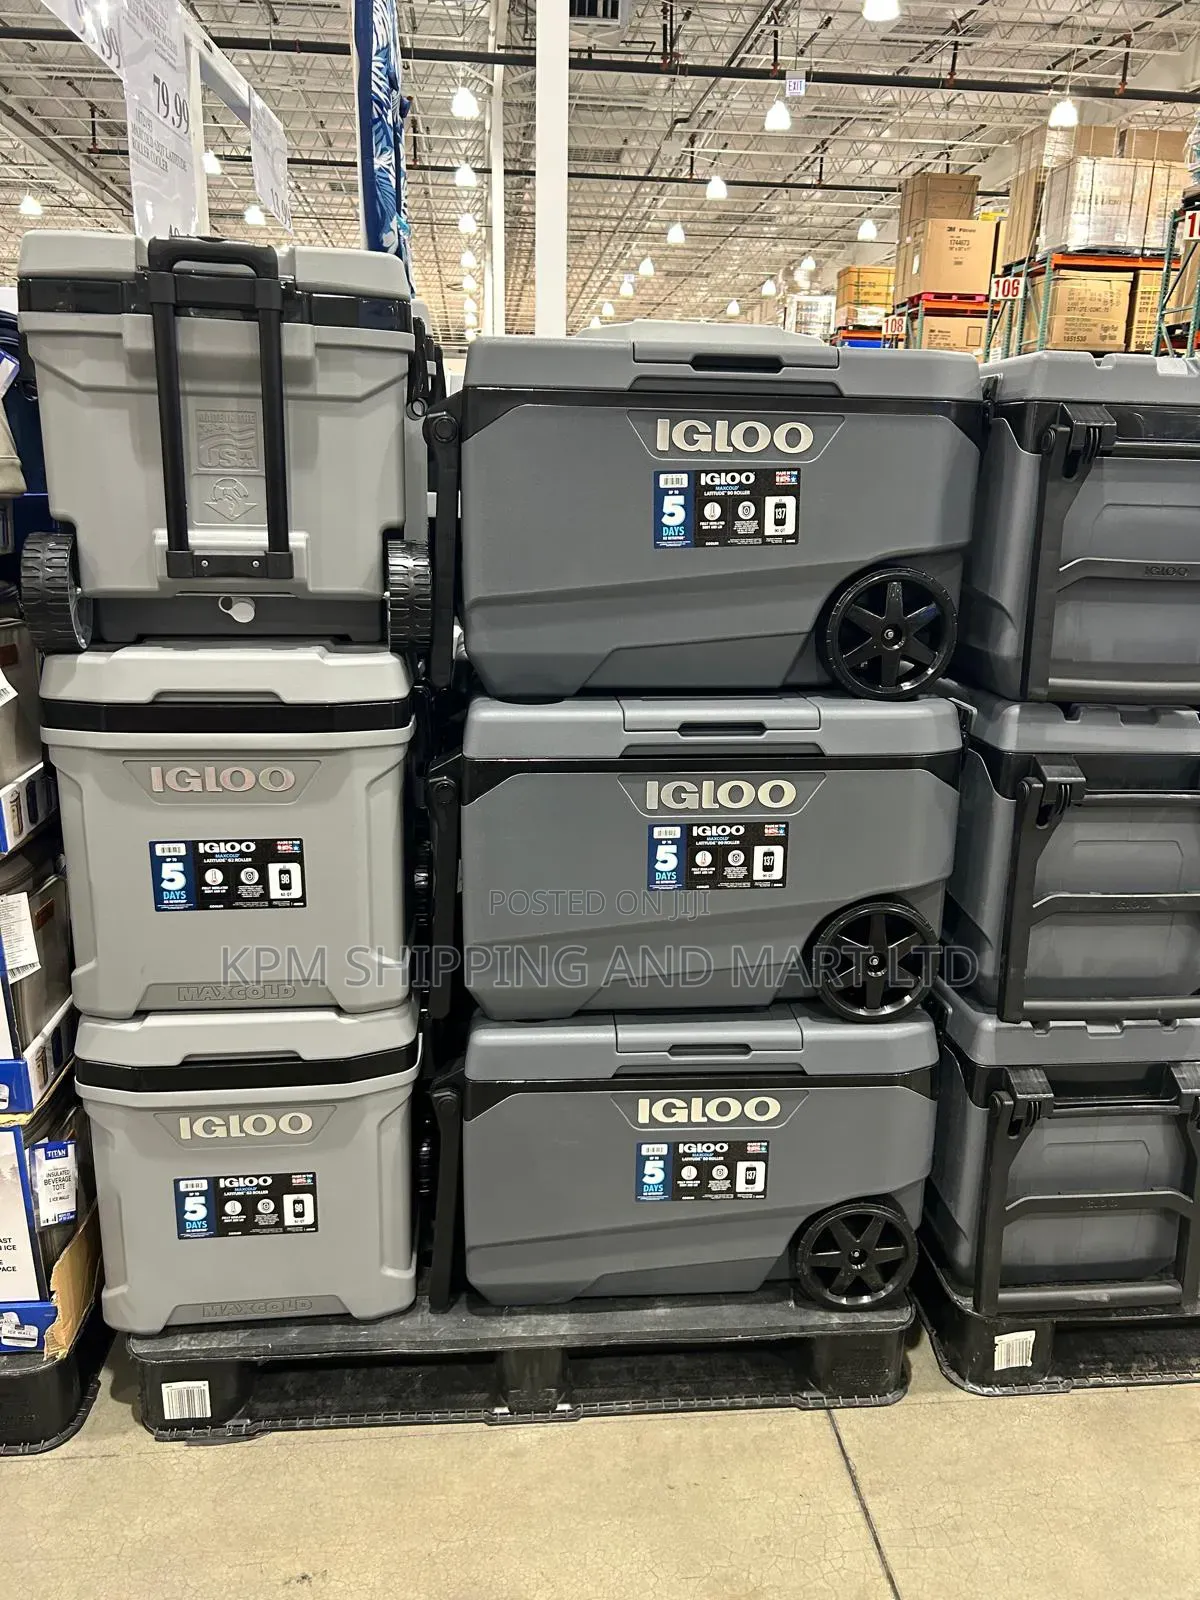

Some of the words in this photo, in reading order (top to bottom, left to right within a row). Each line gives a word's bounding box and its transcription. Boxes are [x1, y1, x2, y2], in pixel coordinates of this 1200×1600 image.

[788, 80, 803, 91] EXIT
[153, 74, 190, 134] 79.99
[1188, 212, 1200, 238] 1
[995, 279, 1020, 297] 106
[884, 319, 904, 333] 108
[656, 419, 814, 454] IGLOO
[700, 472, 756, 486] IGLOO
[661, 495, 686, 526] 5
[775, 508, 786, 519] 137
[663, 526, 685, 536] DAYS
[151, 766, 295, 792] IGLOO
[646, 779, 797, 810] IGLOO
[692, 825, 745, 836] IGLOO
[198, 841, 256, 854] IGLOO
[654, 845, 679, 871] 5
[160, 862, 187, 891] 5
[280, 874, 290, 884] 98
[655, 872, 677, 880] DAYS
[163, 890, 187, 900] DAYS
[178, 984, 296, 1001] MAXCOLD
[637, 1096, 781, 1124] IGLOO
[179, 1112, 313, 1139] IGLOO
[47, 1149, 66, 1157] TITAN
[679, 1143, 728, 1153] IGLOO
[46, 1170, 70, 1178] INSULATED
[642, 1160, 665, 1184] 5
[44, 1175, 71, 1185] BEVERAGE
[219, 1176, 272, 1188] IGLOO
[643, 1184, 664, 1192] DAYS
[183, 1196, 208, 1221] 5
[185, 1221, 208, 1229] DAYS
[202, 1298, 313, 1317] MAXCOLD
